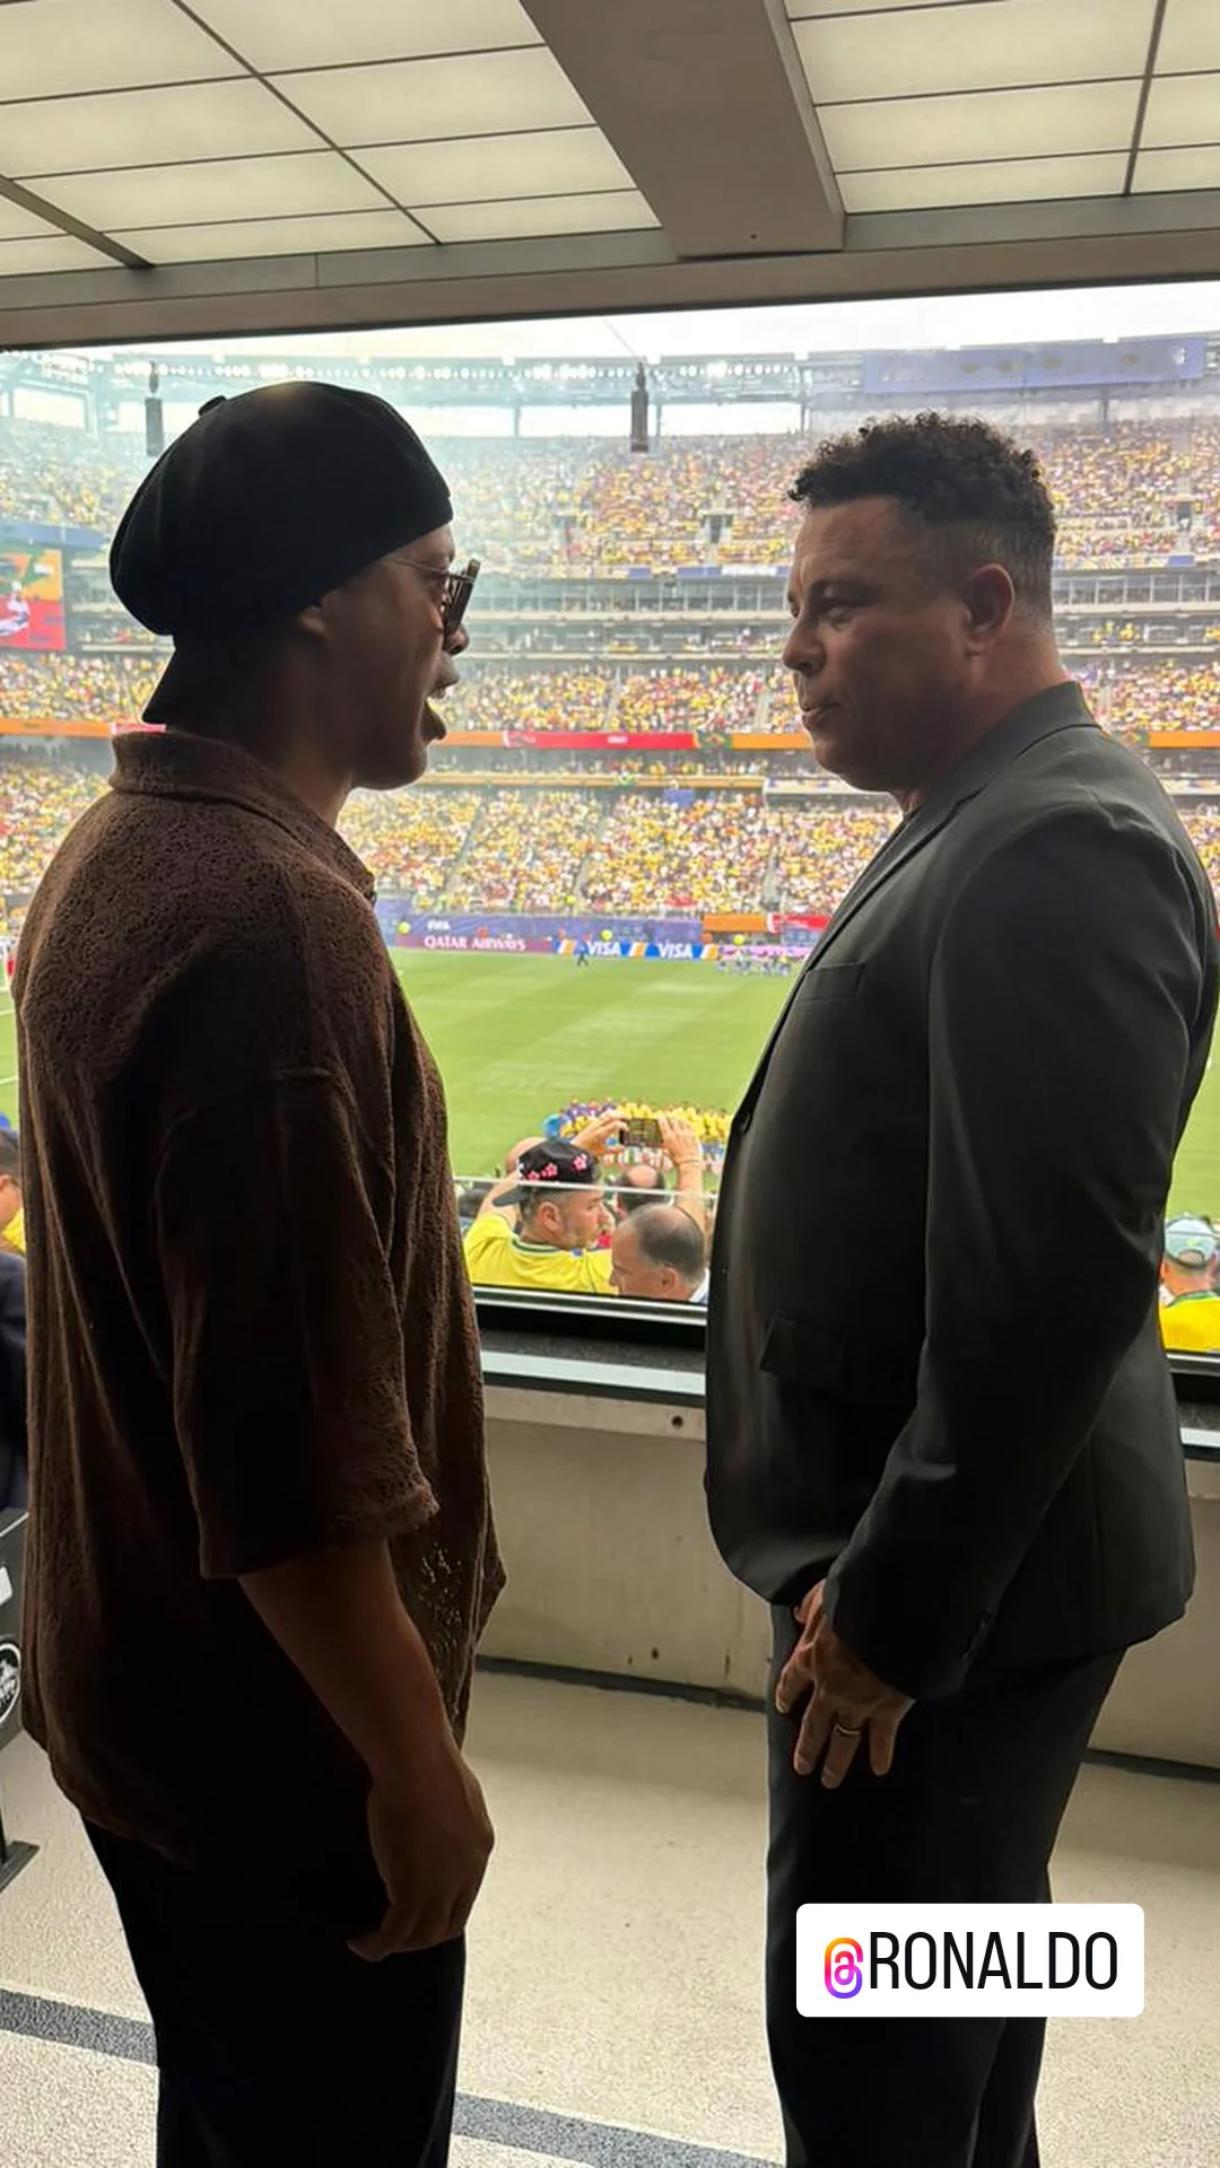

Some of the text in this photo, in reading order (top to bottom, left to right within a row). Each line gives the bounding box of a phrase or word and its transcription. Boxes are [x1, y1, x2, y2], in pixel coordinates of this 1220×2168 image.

[424, 934, 527, 951] QATAR AIRWAYS
[588, 941, 620, 956] VISA
[657, 941, 692, 958] VISA
